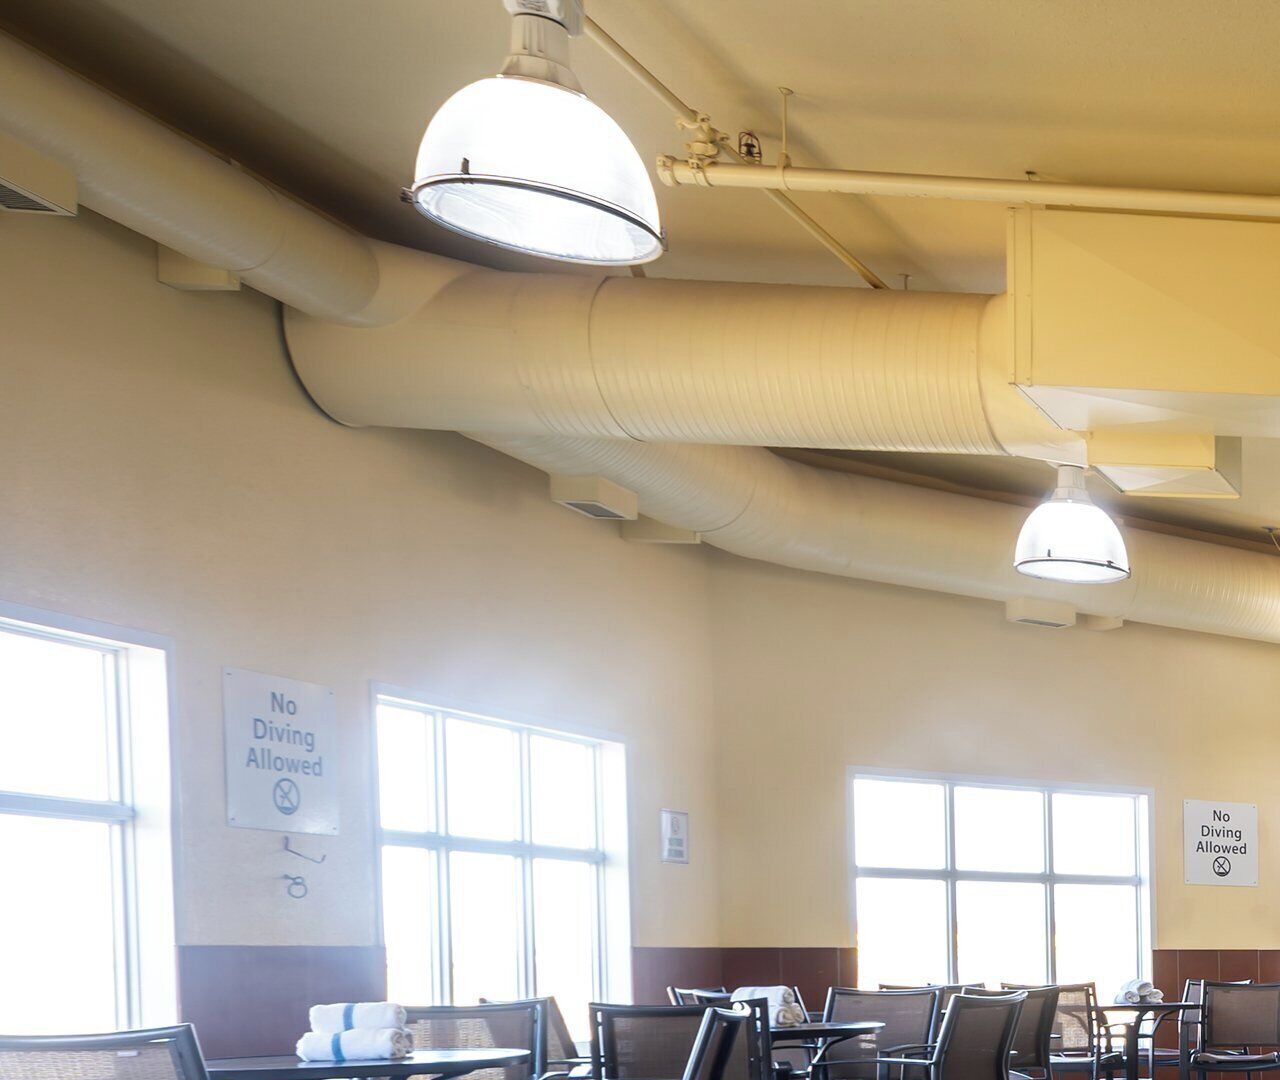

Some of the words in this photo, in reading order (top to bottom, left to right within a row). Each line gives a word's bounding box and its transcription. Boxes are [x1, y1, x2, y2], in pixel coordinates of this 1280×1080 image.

[271, 692, 297, 715] No
[253, 718, 315, 752] Diving
[246, 747, 323, 777] Allowed
[1213, 809, 1230, 822] No
[1201, 825, 1241, 841] Diving
[1196, 841, 1247, 855] Allowed
